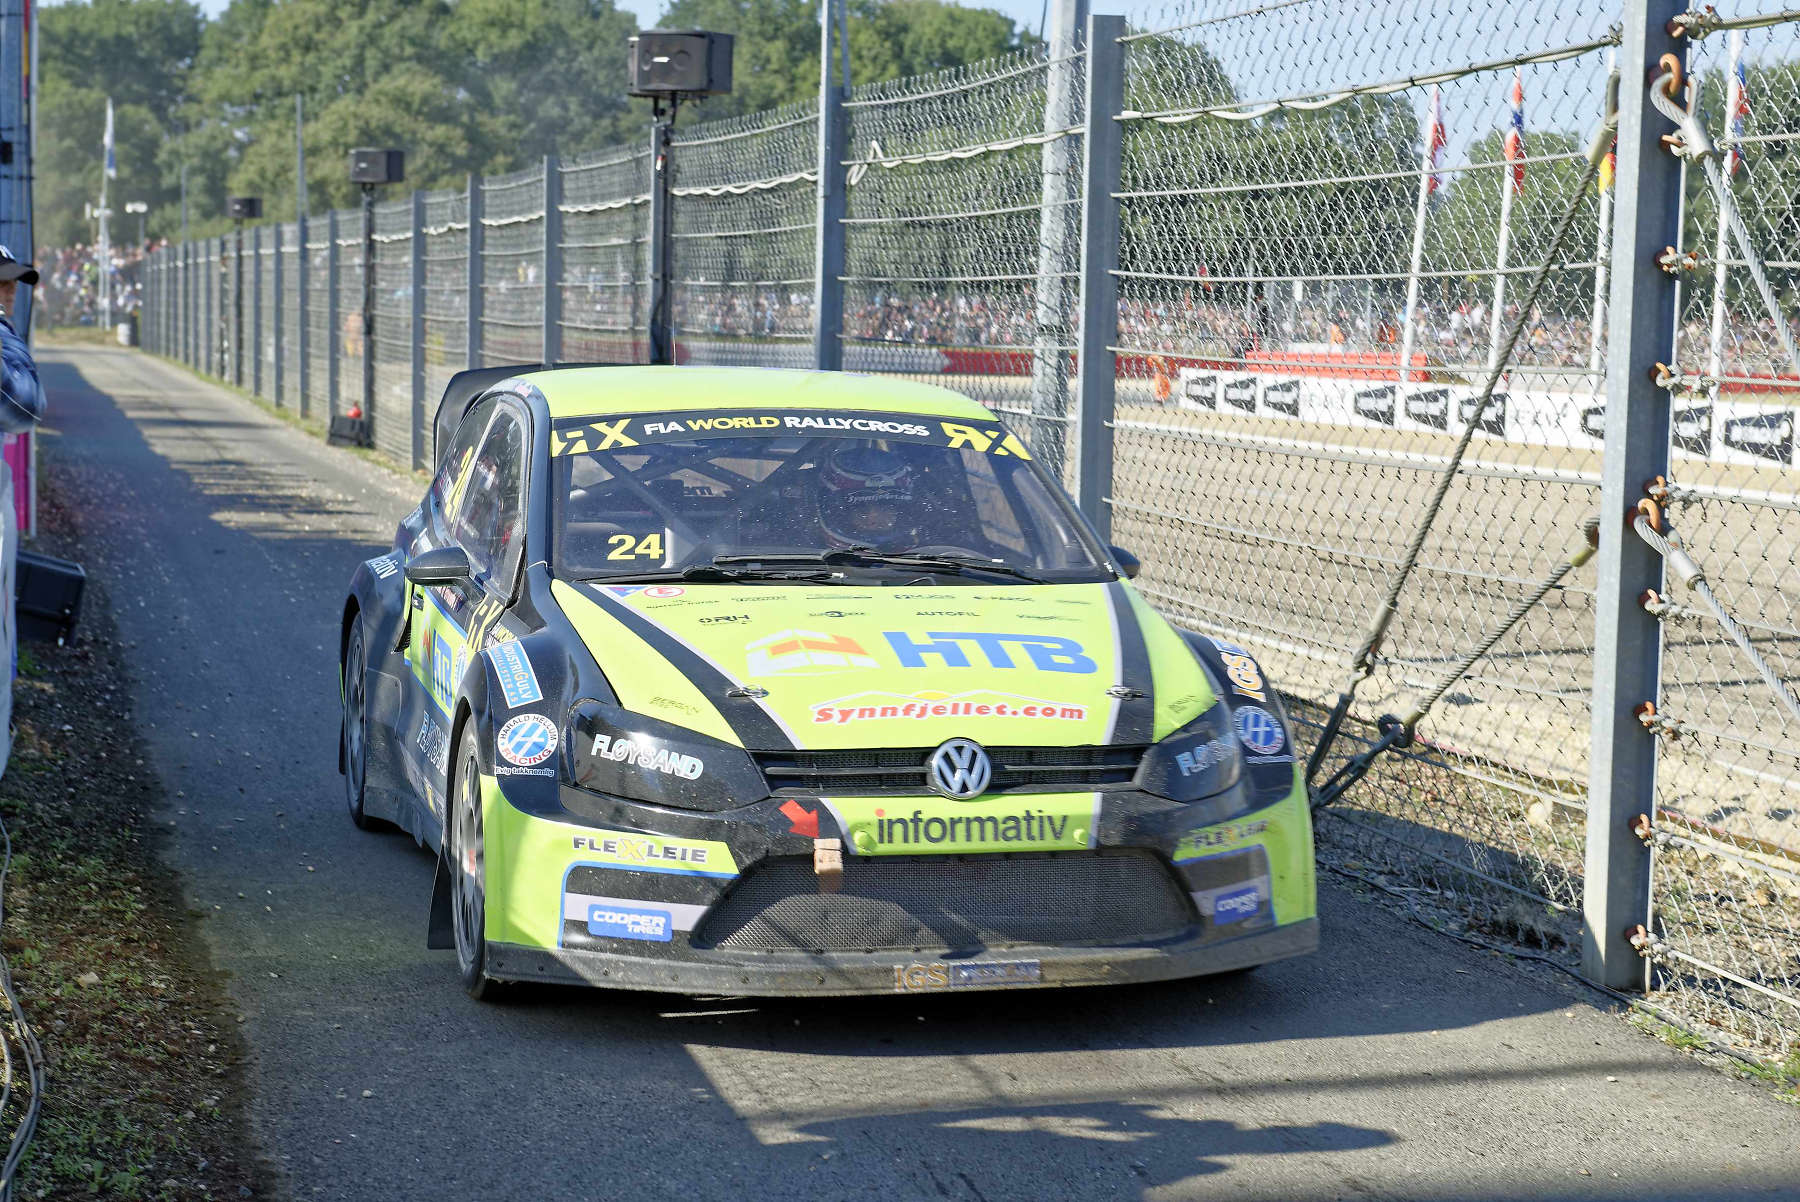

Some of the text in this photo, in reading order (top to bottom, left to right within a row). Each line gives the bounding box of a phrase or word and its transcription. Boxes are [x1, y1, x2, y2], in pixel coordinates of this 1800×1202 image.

[643, 416, 930, 437] FIA WORLD RALLYCROSS
[606, 534, 665, 561] 24
[882, 630, 1098, 674] HTB
[813, 702, 1086, 724] Synnfjellet.com
[500, 715, 557, 741] HARALD HELLUM
[502, 747, 552, 765] RACING
[591, 733, 704, 780] FLØYSAND
[875, 808, 1068, 844] informativ
[572, 836, 707, 863] FLEXLEIE
[592, 910, 666, 926] COOPER
[626, 923, 664, 937] TIRES
[892, 962, 949, 992] IGS
